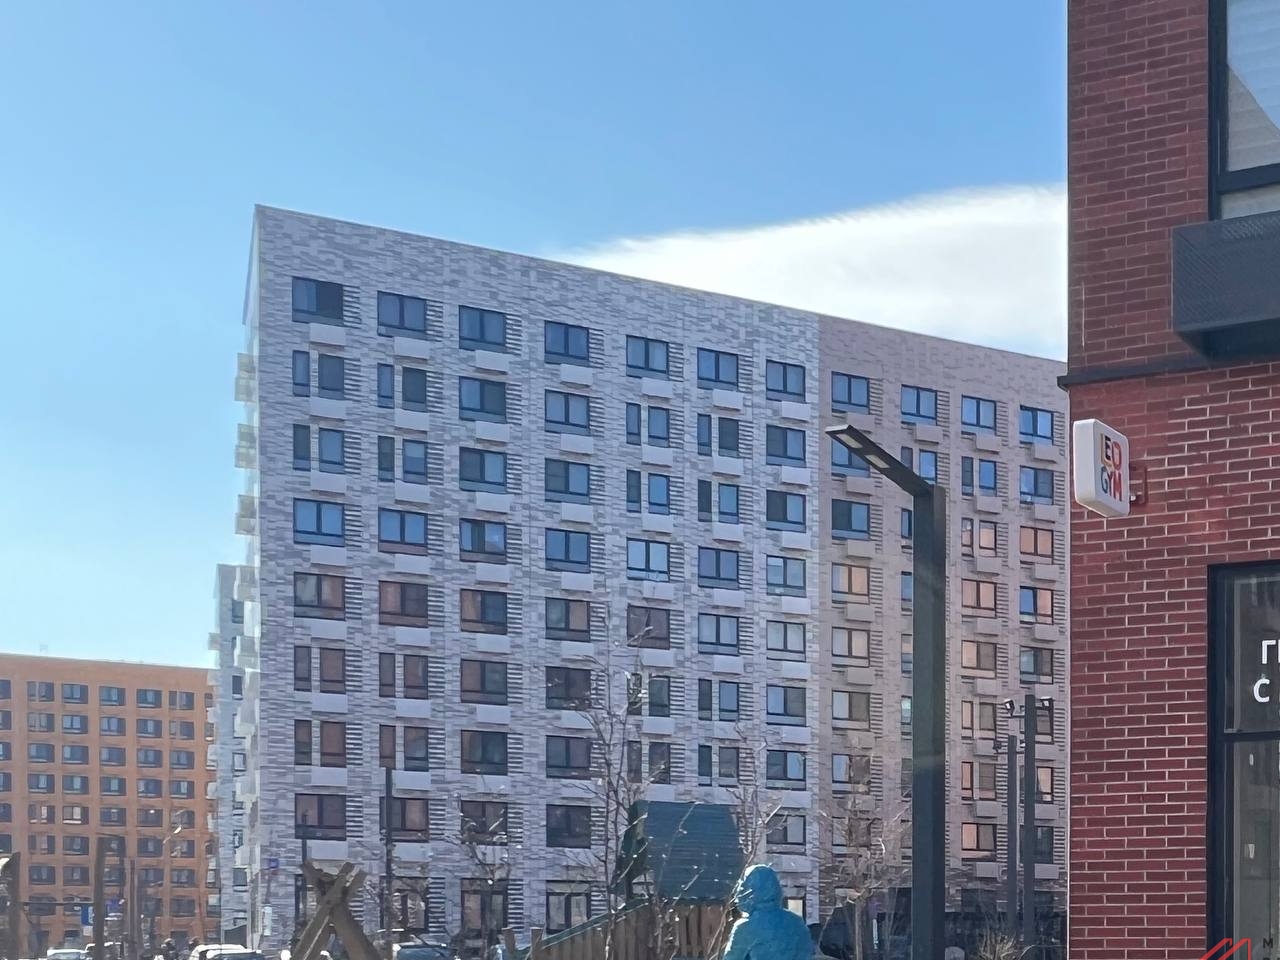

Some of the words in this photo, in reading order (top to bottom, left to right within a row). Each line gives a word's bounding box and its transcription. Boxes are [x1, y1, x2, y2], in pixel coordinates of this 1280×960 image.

[1100, 433, 1122, 471] LEO
[1100, 465, 1122, 502] GYM
[1253, 678, 1271, 703] С
